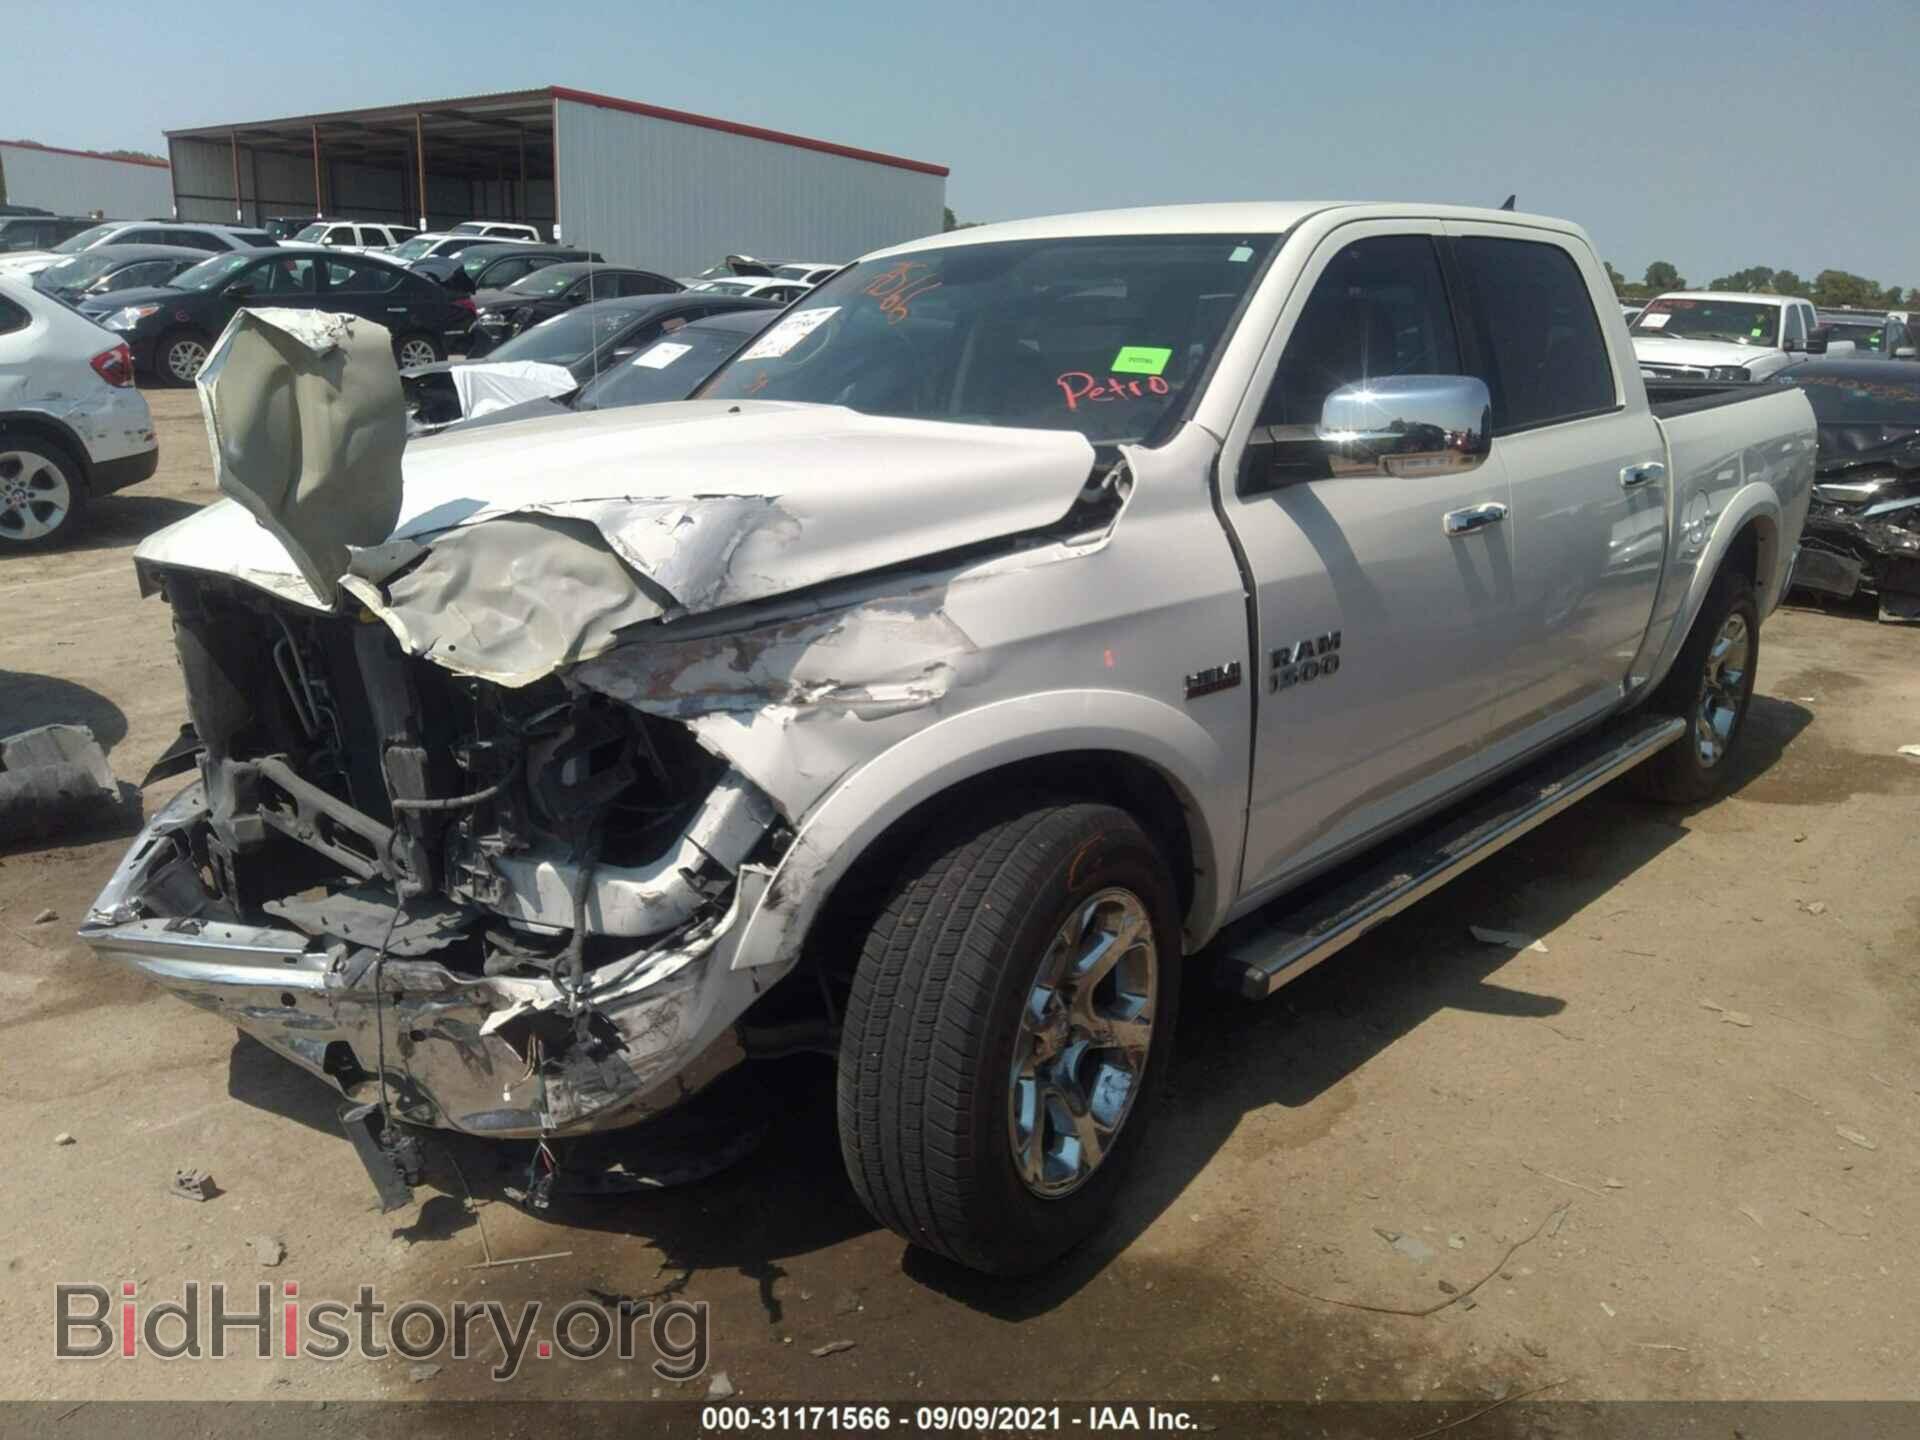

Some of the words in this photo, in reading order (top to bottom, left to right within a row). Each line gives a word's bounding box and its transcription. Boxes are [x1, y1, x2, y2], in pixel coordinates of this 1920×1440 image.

[1057, 371, 1169, 411] Petro
[1270, 631, 1342, 669] RAM
[1269, 653, 1341, 694] 1500
